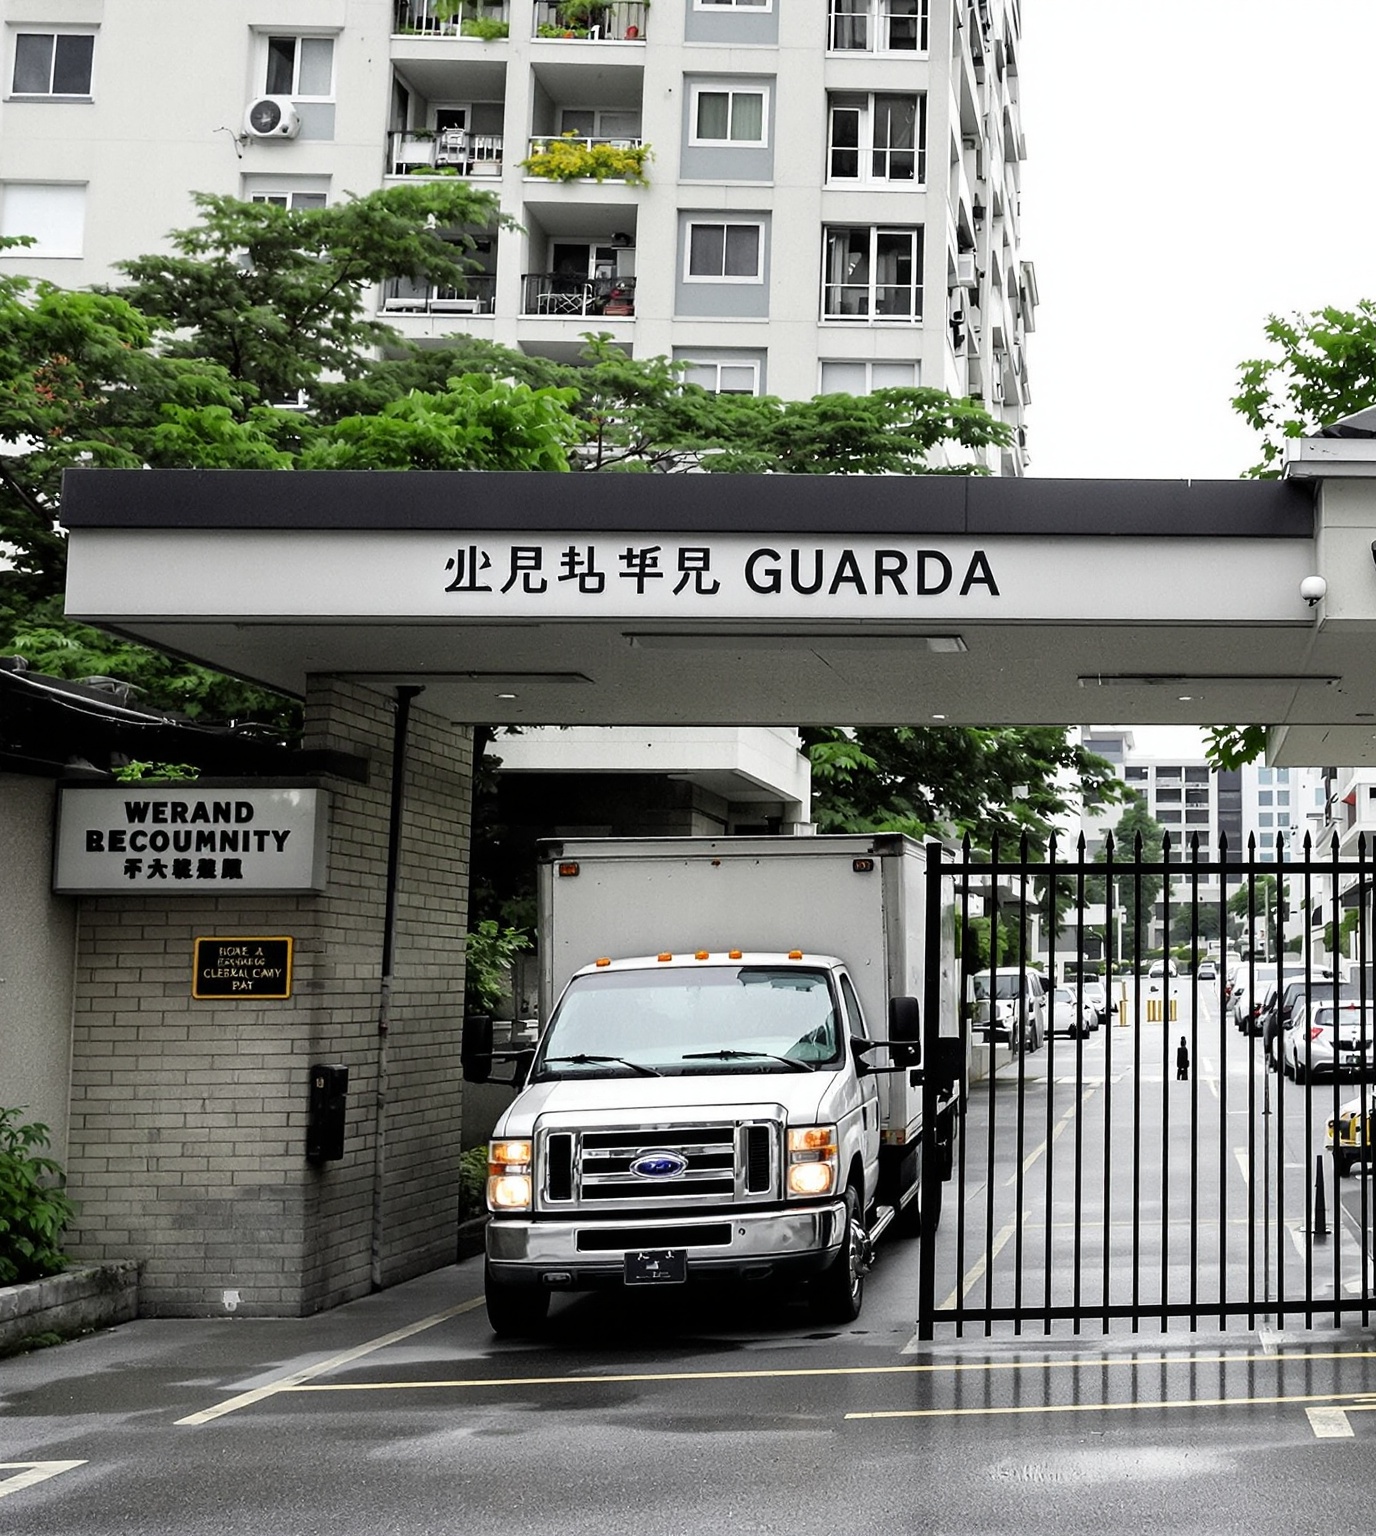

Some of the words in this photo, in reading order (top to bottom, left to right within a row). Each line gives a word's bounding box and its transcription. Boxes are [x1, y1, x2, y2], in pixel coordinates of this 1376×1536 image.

[745, 548, 1001, 597] GUARDA
[123, 801, 255, 824] WERAND
[85, 829, 291, 853] BECOUMNITY
